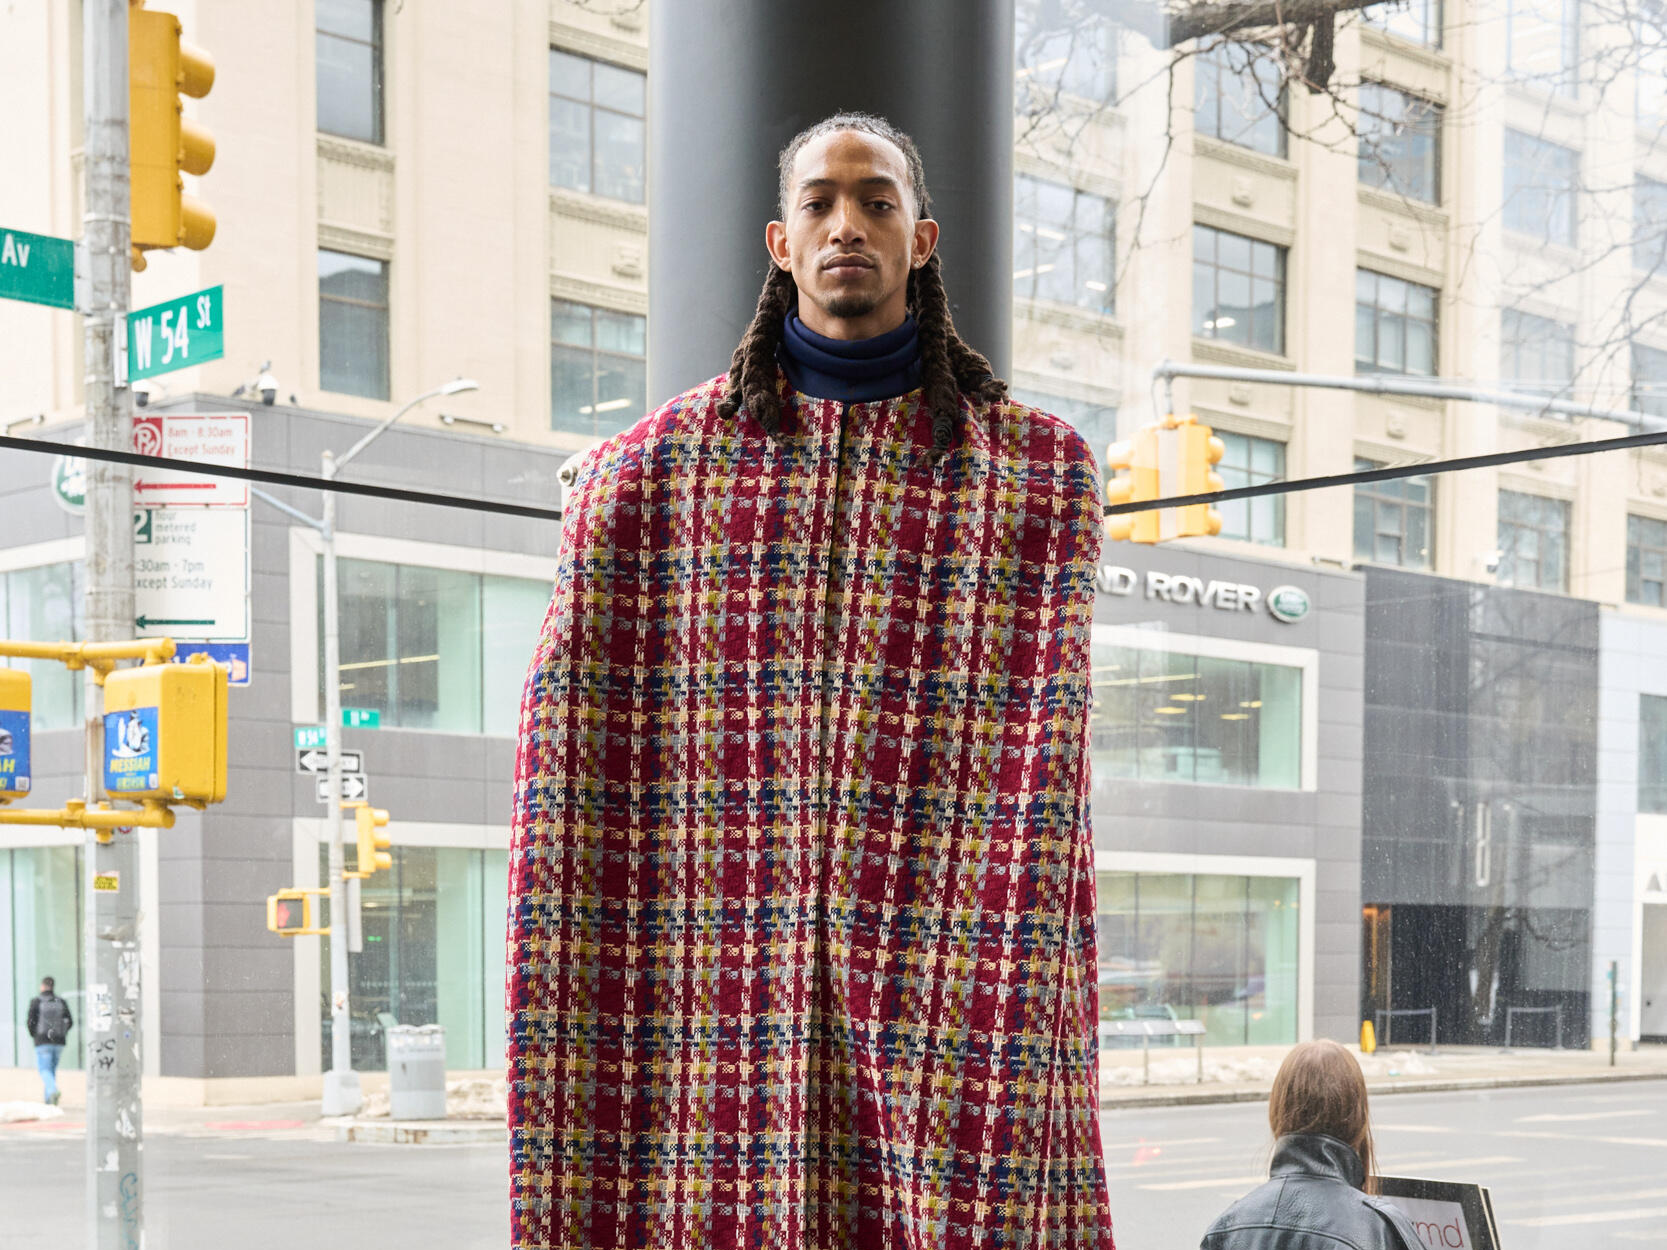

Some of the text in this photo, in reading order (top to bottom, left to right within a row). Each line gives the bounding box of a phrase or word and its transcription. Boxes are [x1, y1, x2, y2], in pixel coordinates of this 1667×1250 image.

[1, 233, 30, 268] Av
[134, 294, 211, 371] W 54 St
[167, 443, 236, 457] Except Sunday
[134, 507, 149, 543] 2
[155, 521, 197, 532] metered
[155, 534, 191, 546] parking
[135, 559, 170, 573] :30am
[182, 559, 205, 574] 7pm
[136, 576, 214, 592] xcept Sunday
[1097, 564, 1138, 596] ND
[1145, 570, 1262, 613] ROVER
[1415, 1217, 1464, 1248] md
